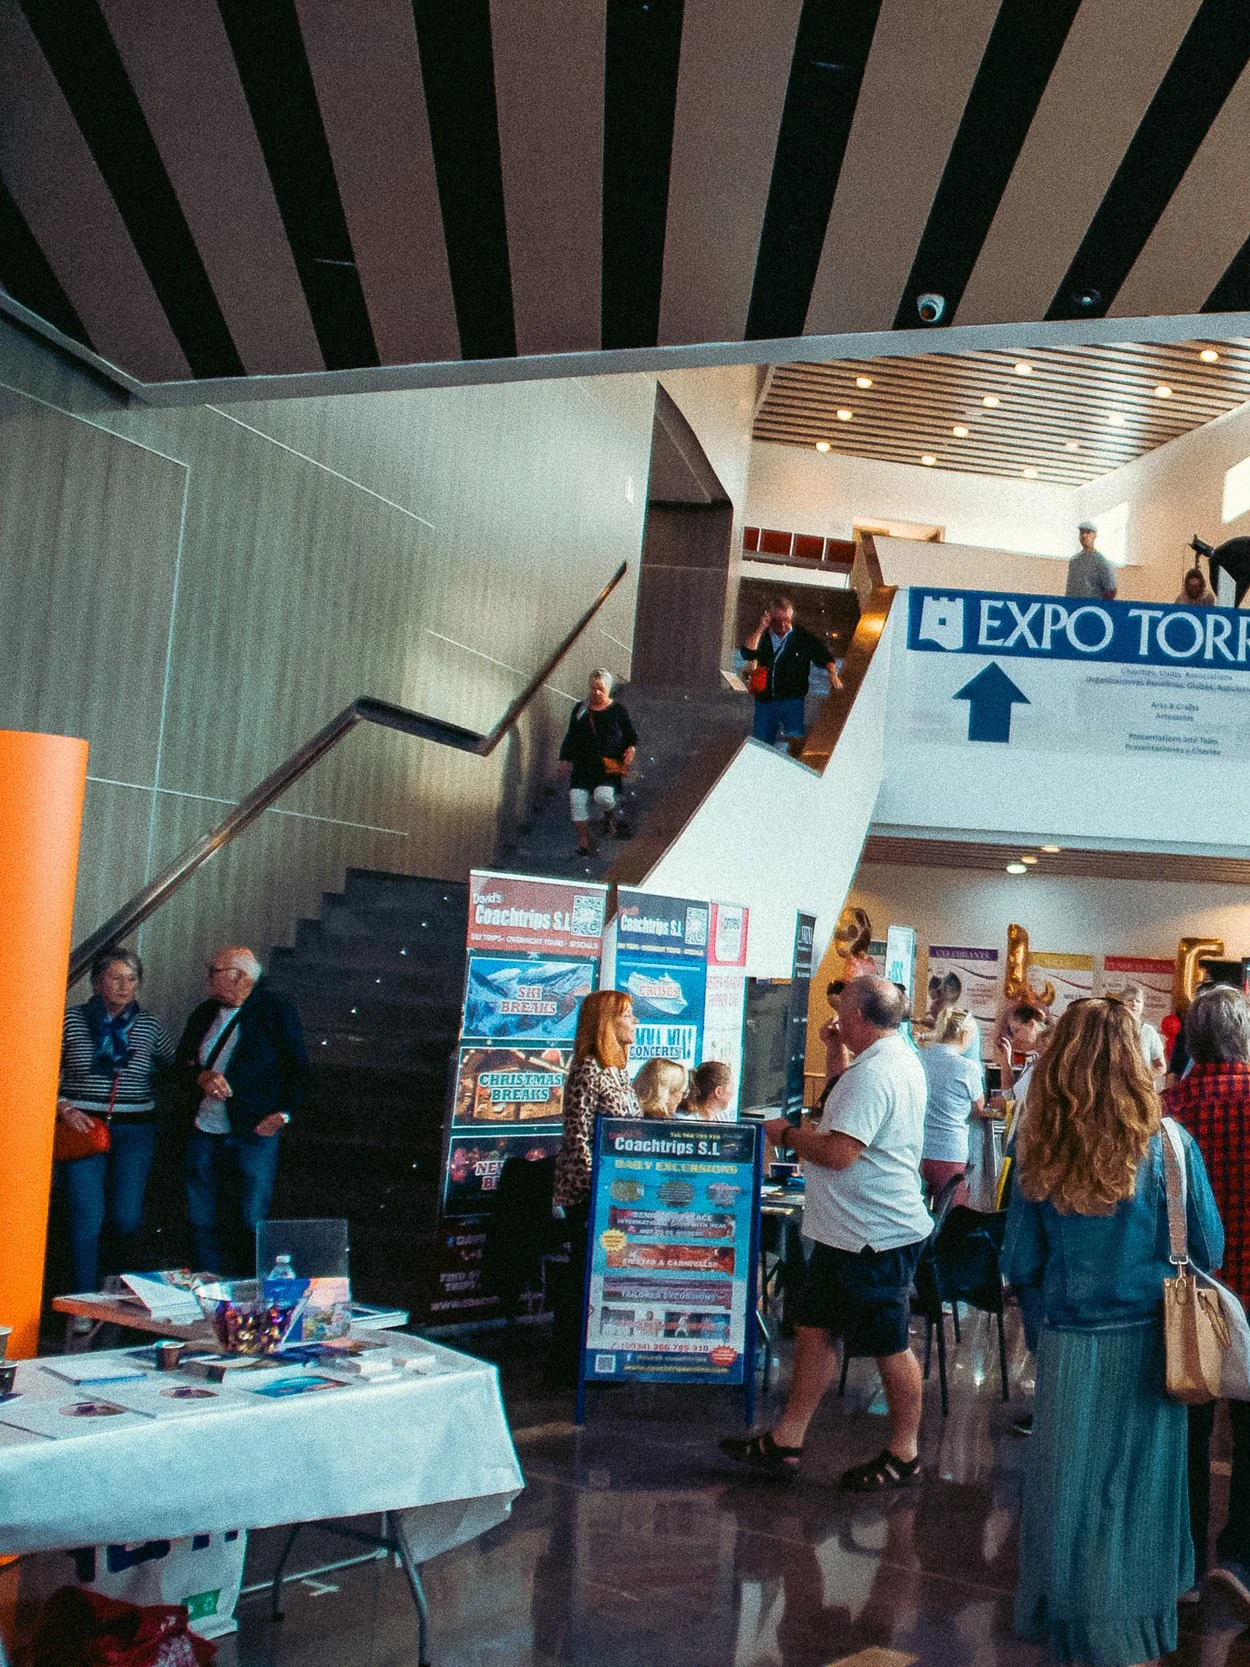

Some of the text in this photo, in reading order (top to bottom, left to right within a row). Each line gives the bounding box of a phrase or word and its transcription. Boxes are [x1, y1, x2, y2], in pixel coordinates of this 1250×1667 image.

[978, 599, 1113, 653] EXPO
[475, 904, 551, 931] Coachtrips
[621, 914, 669, 937] Coachtrips
[517, 986, 542, 999] SKI
[639, 984, 680, 998] CRUISES
[500, 1001, 558, 1016] BREAKS
[630, 1045, 680, 1058] CONCERTS
[479, 1072, 564, 1087] CHRISTMAS
[491, 1088, 550, 1103] BREAKS
[614, 1137, 721, 1156] Coachtrips S.L
